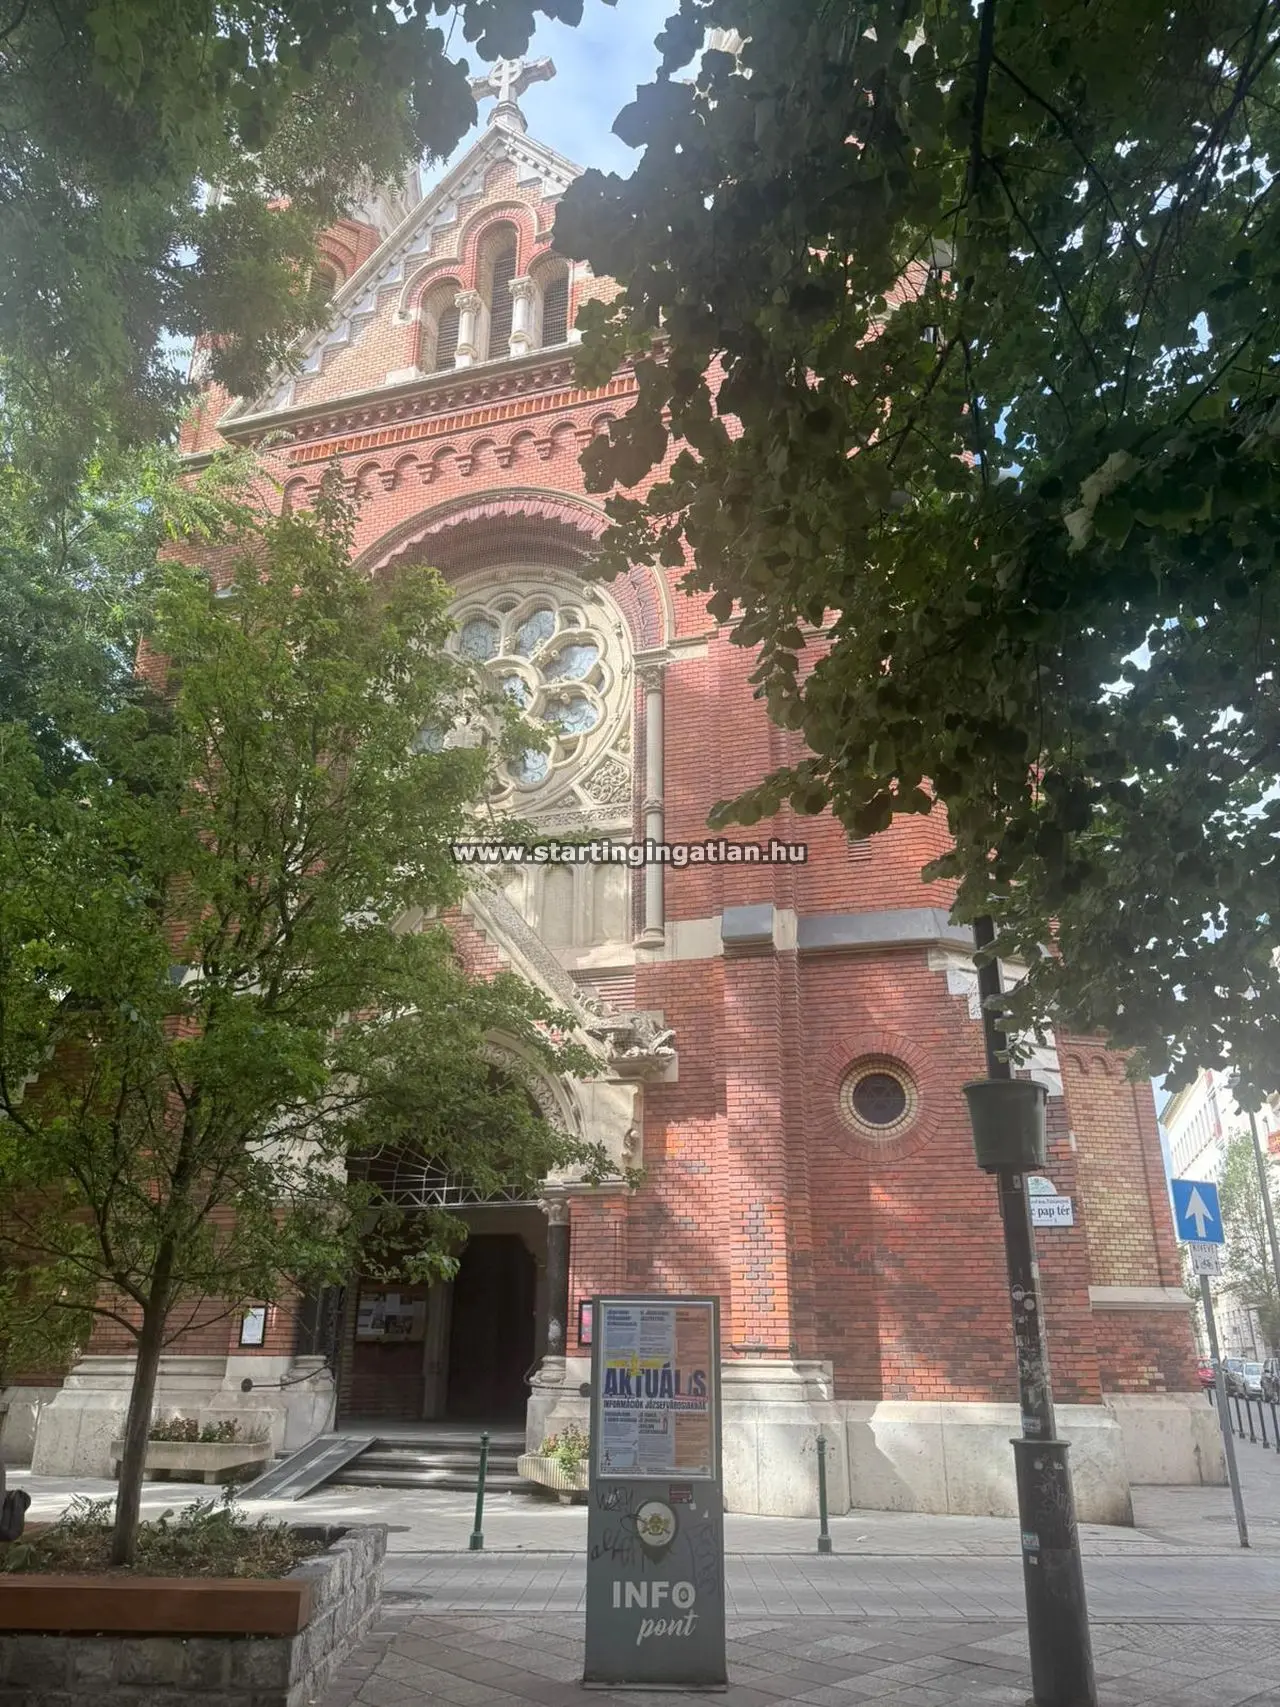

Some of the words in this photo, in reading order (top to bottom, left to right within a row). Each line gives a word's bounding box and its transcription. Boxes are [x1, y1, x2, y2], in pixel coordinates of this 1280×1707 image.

[1037, 1207, 1055, 1218] pap
[1057, 1204, 1071, 1216] tér
[612, 1580, 696, 1609] INFO
[636, 1608, 700, 1646] pont
